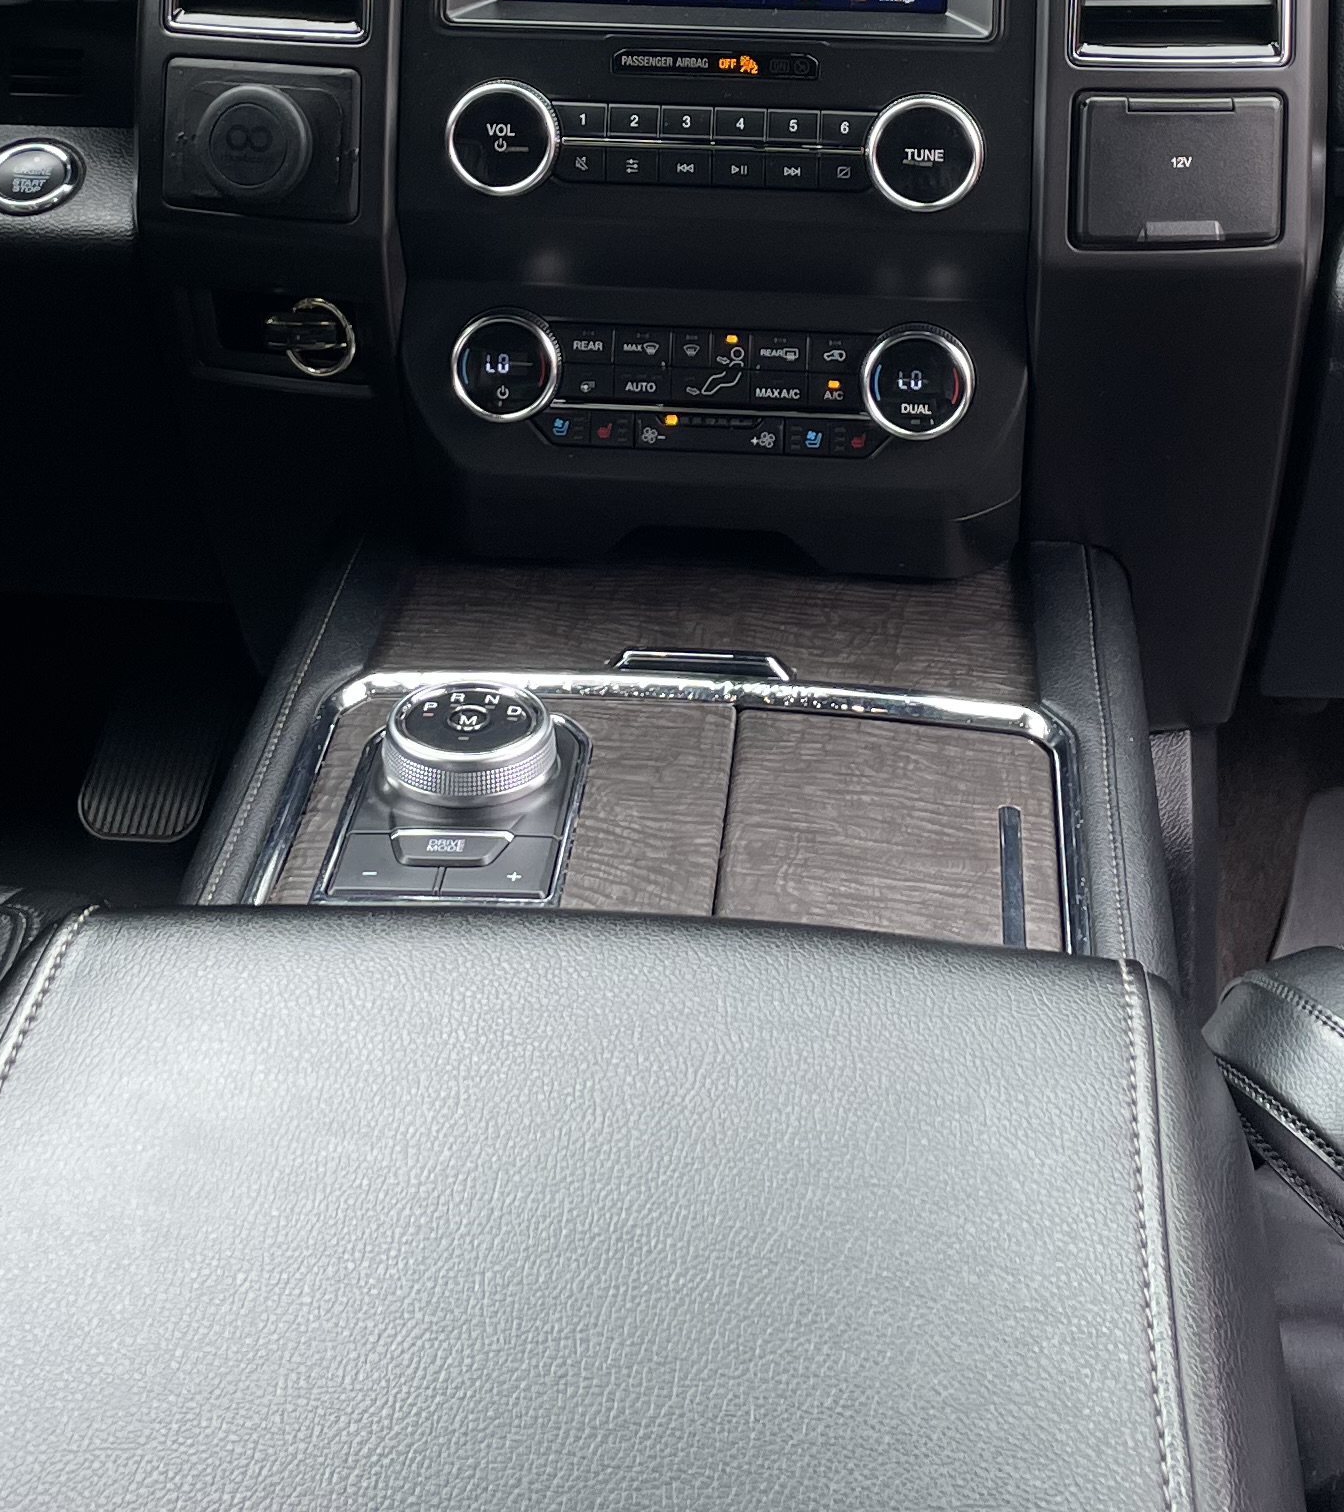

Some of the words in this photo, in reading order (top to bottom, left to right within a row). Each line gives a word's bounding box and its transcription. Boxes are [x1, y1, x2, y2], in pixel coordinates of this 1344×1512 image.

[621, 55, 673, 67] PASSENGER
[676, 57, 709, 68] AIRBAG
[718, 58, 736, 69] OFF
[579, 113, 587, 126] 1
[630, 114, 639, 128] 2
[682, 115, 691, 128] 3
[735, 117, 745, 131] 4
[486, 123, 516, 137] VOL
[789, 119, 798, 133] 5
[840, 121, 849, 134] 6
[904, 148, 944, 162] TUNE
[1171, 156, 1193, 168] 12V
[12, 178, 46, 187] START
[12, 186, 41, 194] STOP
[573, 341, 603, 351] REAR
[623, 343, 643, 352] MAX
[760, 348, 783, 357] REAR
[485, 353, 510, 374] LO
[897, 370, 923, 390] LO
[625, 382, 656, 393] AUTO
[756, 388, 780, 399] MAX
[780, 389, 800, 400] A/C
[823, 390, 844, 401] A/C
[901, 403, 932, 415] DUAL
[451, 692, 466, 704] R
[485, 693, 499, 705] N
[423, 701, 438, 712] P
[506, 705, 523, 717] D
[459, 714, 478, 726] M
[426, 844, 464, 852] MODE
[428, 838, 465, 846] DRIVE
